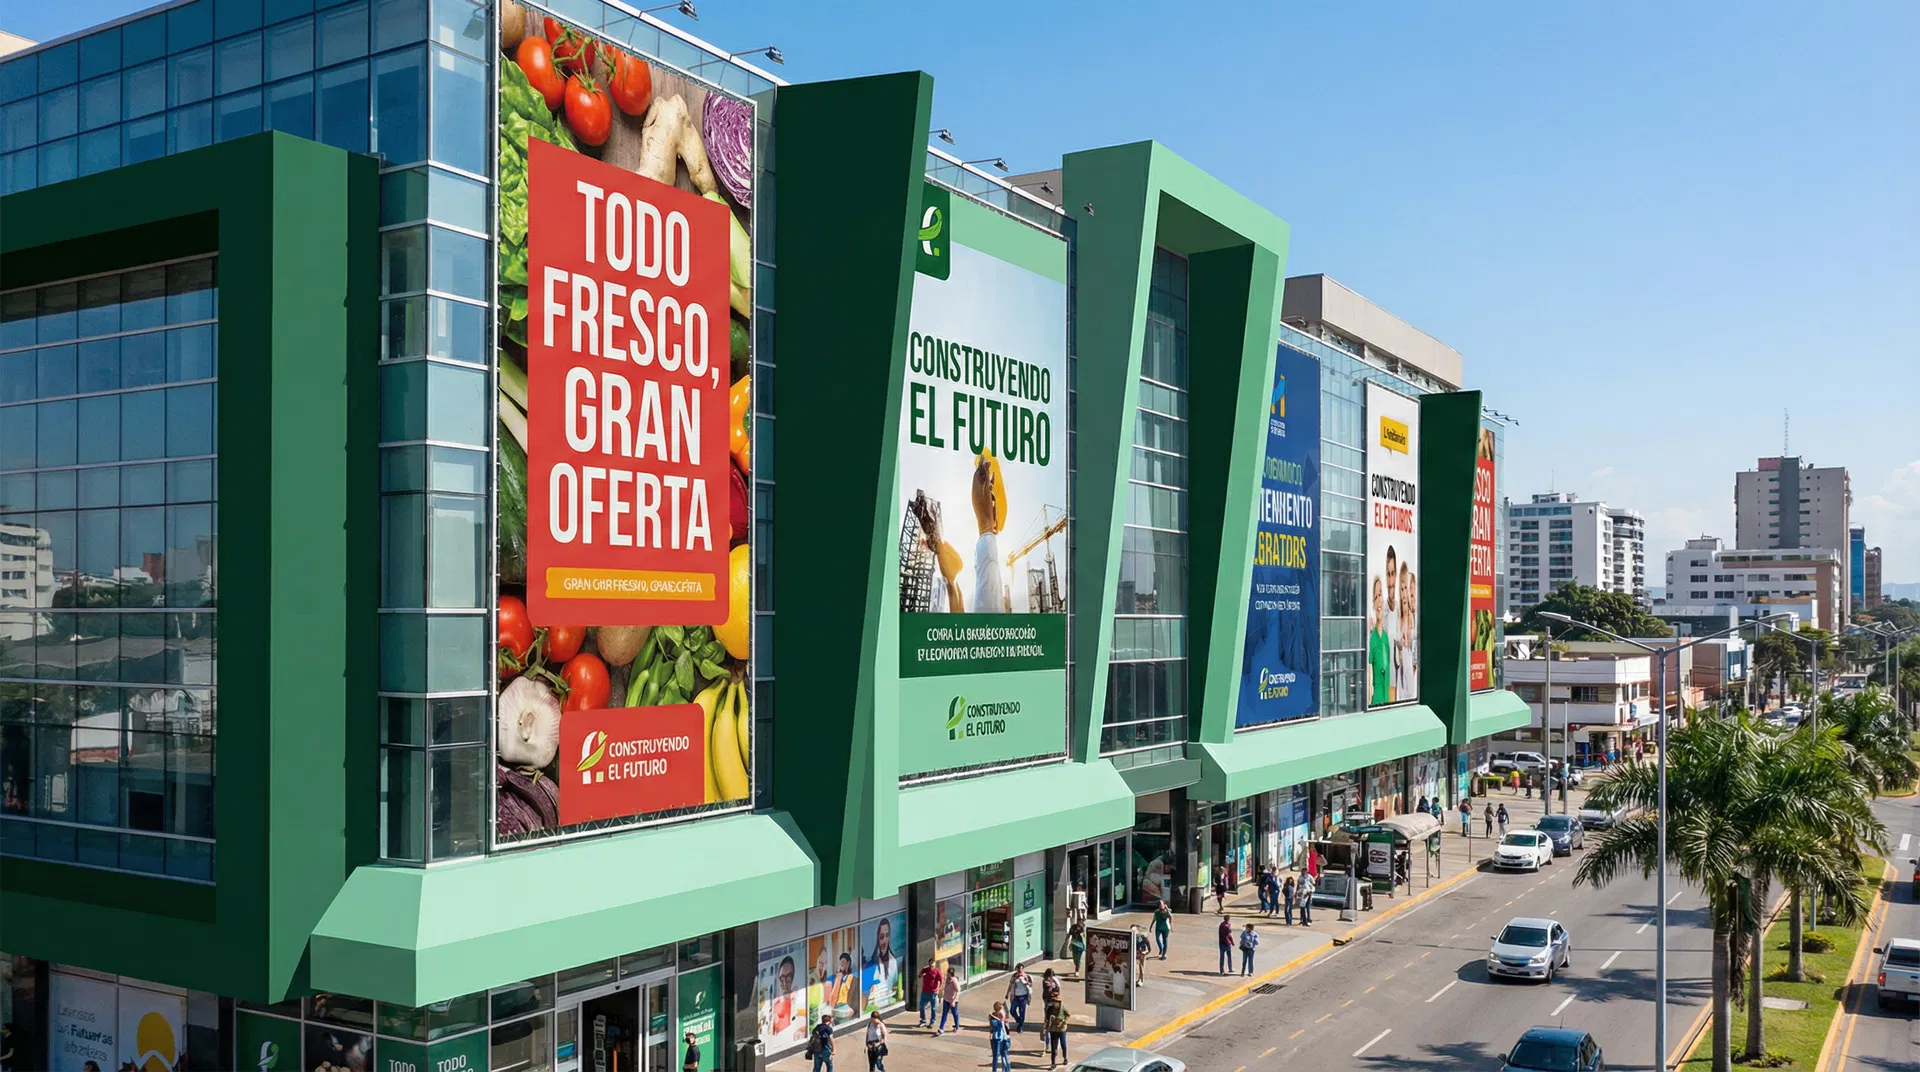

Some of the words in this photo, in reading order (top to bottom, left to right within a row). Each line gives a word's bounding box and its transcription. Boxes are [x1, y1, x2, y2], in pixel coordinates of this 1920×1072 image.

[577, 180, 690, 287] TODO
[544, 265, 719, 389] FRESCO,
[910, 331, 1052, 404] CONSTRUYENDO
[565, 366, 701, 466] GRAN
[910, 381, 945, 448] EL
[953, 391, 1051, 467] FUTURO
[549, 462, 713, 552] OFERTA
[1375, 502, 1383, 528] EL
[1471, 504, 1491, 542] RAN
[609, 735, 690, 758] CONSTRUYENDO
[966, 722, 976, 737] EL
[976, 719, 1006, 737] FUTURO
[608, 763, 621, 780] EL
[623, 758, 668, 779] FUTURO
[437, 1054, 467, 1072] TODO
